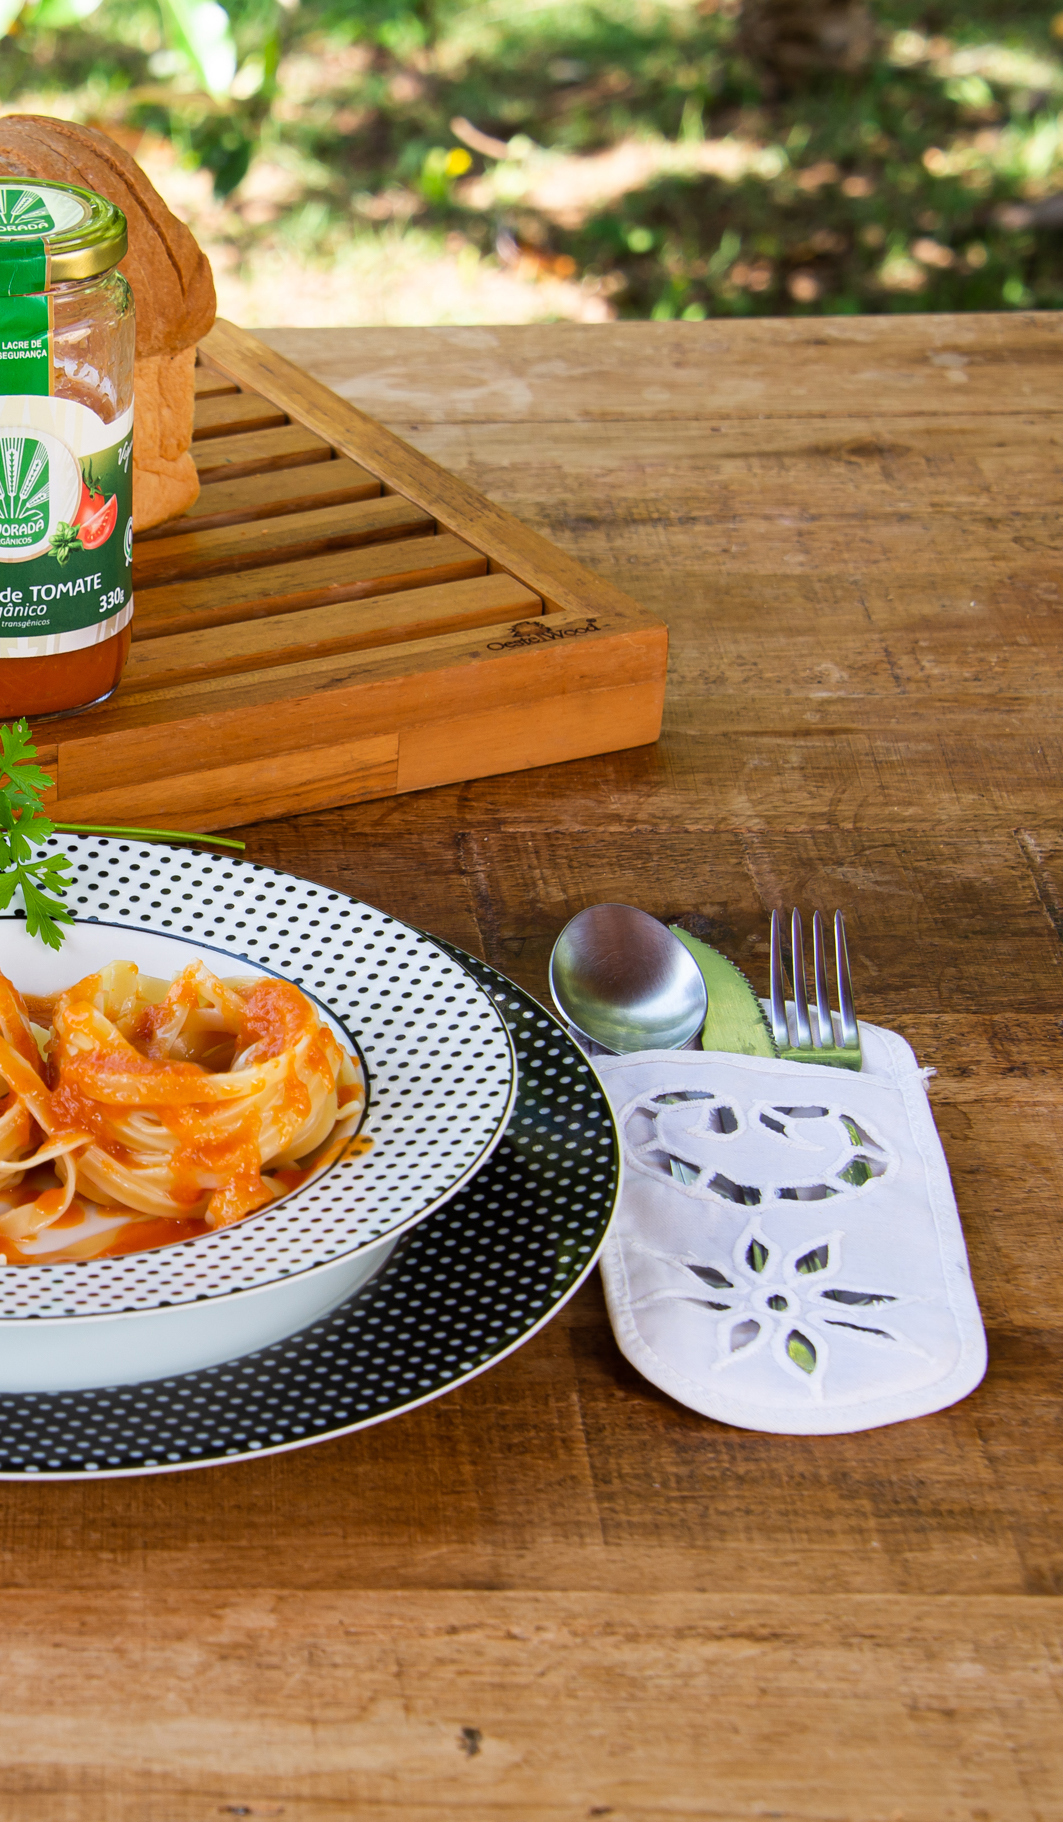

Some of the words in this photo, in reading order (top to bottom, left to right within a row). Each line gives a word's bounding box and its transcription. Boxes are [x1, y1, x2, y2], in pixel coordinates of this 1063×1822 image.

[1, 340, 30, 350] LACRE
[30, 339, 43, 349] DE
[29, 572, 102, 602] TOMATE
[1, 618, 51, 629] transgênicos
